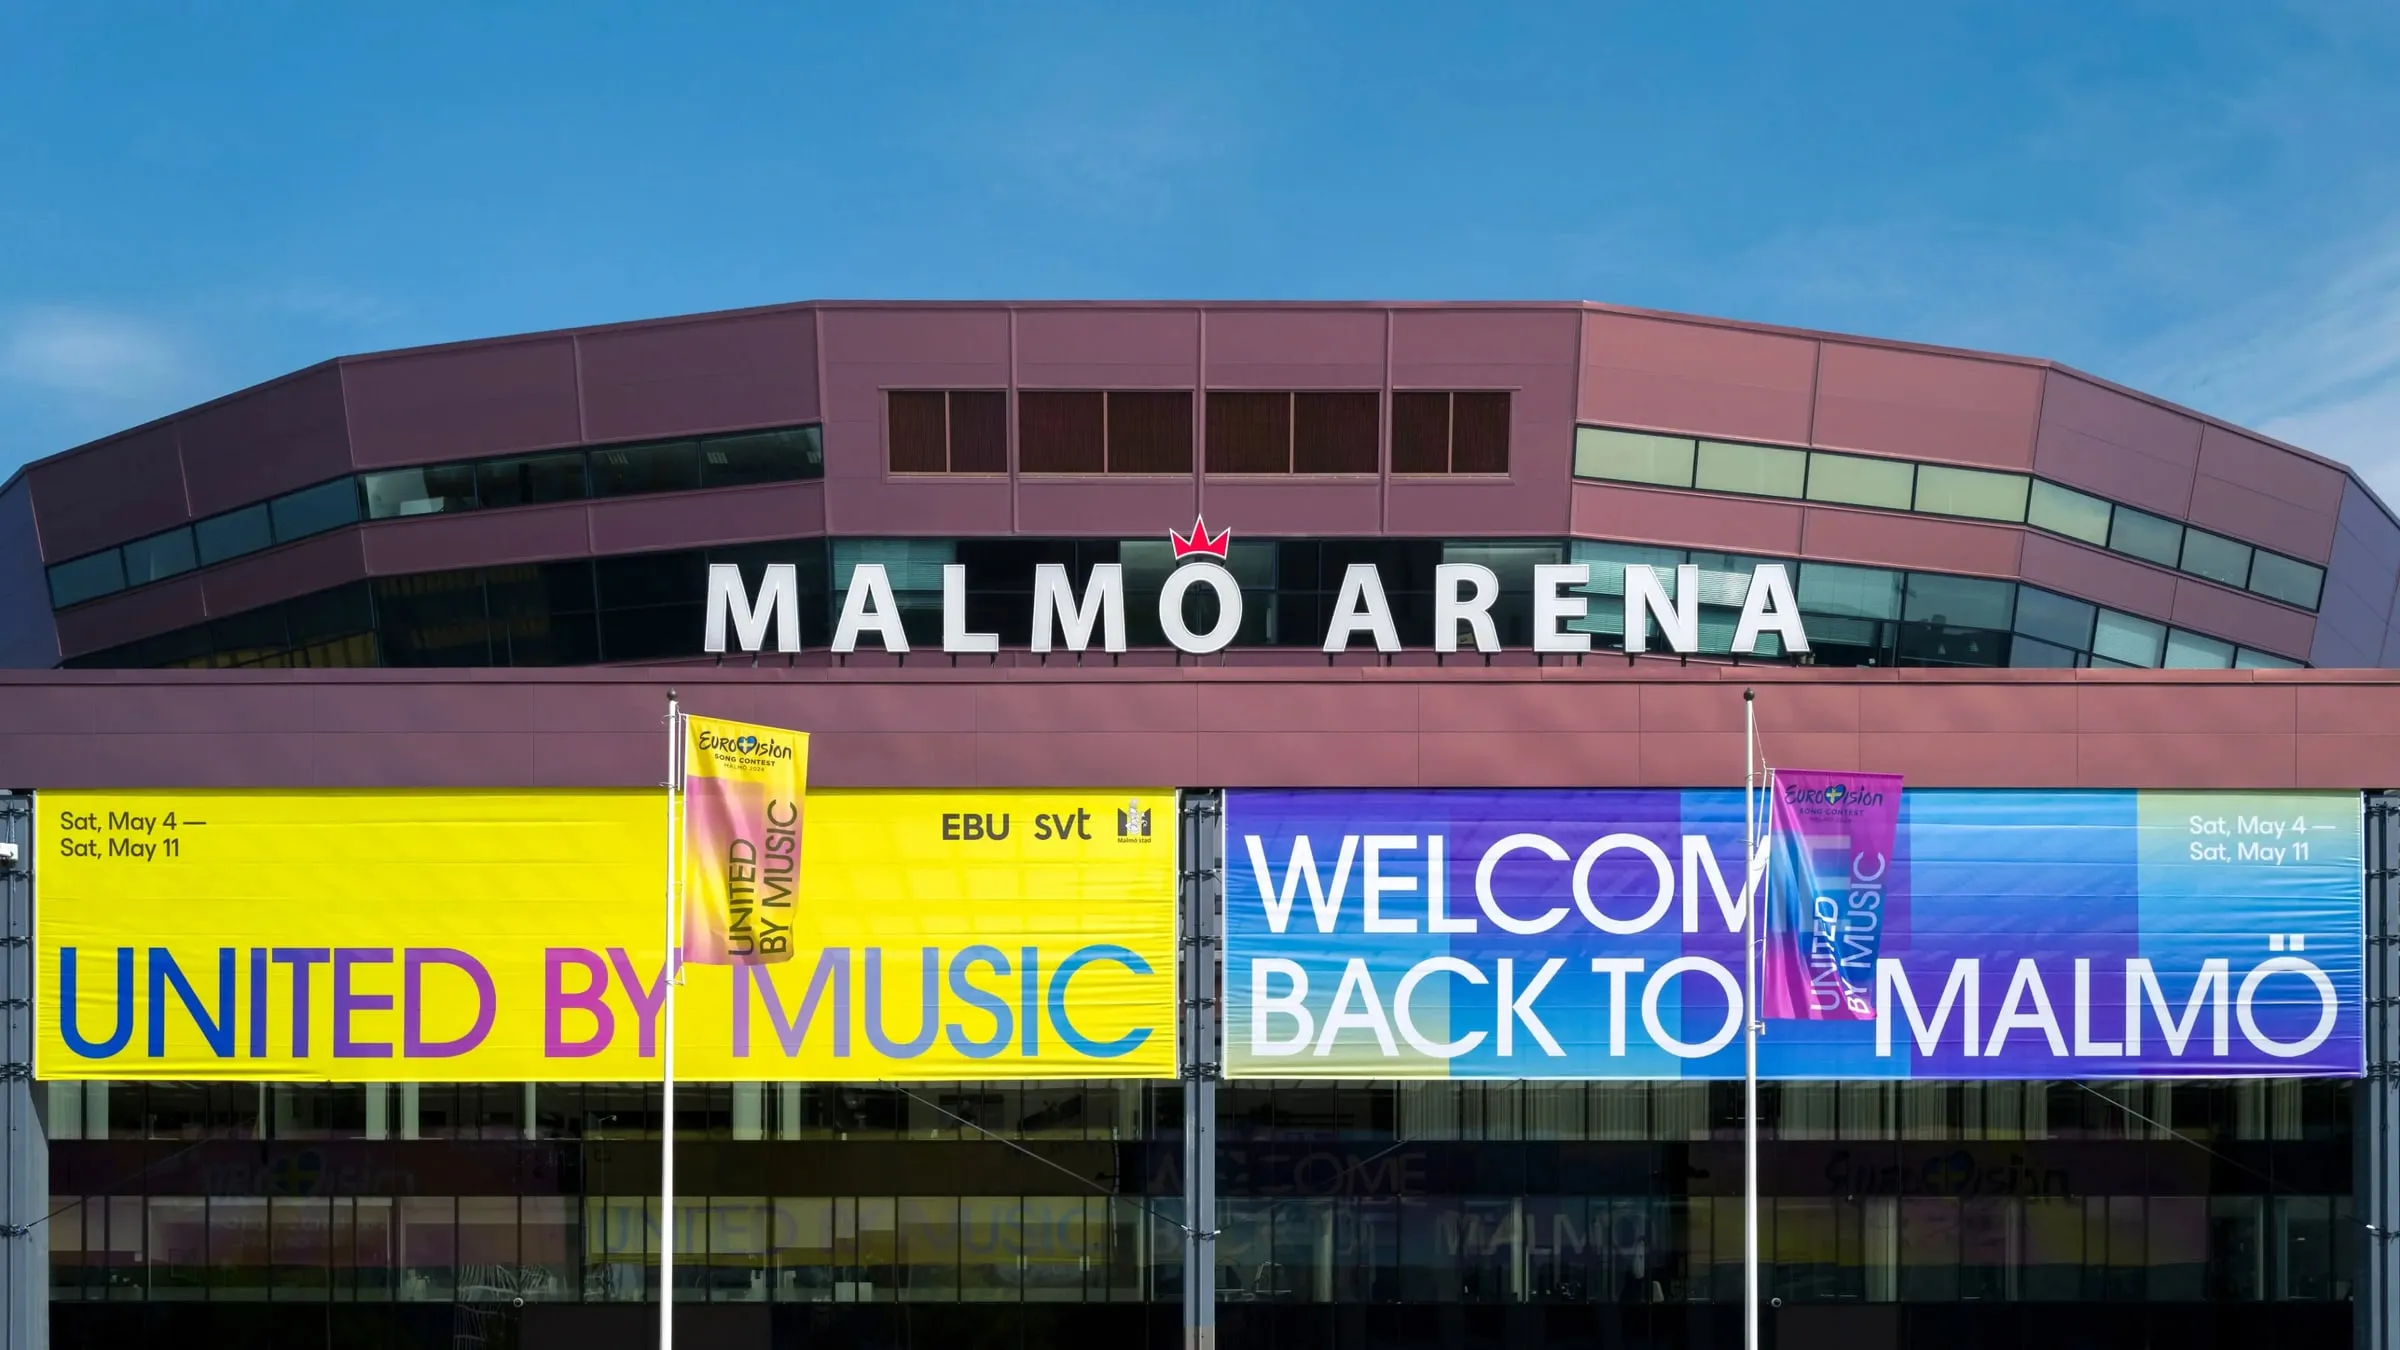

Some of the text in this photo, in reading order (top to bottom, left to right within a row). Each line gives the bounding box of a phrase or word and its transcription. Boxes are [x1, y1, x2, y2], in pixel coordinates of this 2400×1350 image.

[1323, 562, 1810, 654] ARENA
[714, 753, 775, 767] SONG CONTEST
[60, 811, 102, 833] Sat,
[108, 811, 156, 835] May
[162, 812, 177, 830] 4
[942, 808, 1092, 840] EBU svt
[1800, 807, 1864, 817] SONG CONTEST
[2189, 815, 2231, 837] Sat,
[2238, 815, 2286, 839] May
[2291, 816, 2306, 834] 4
[60, 838, 179, 862] Sat, May 11
[760, 799, 797, 954] BY MUSIC
[2189, 841, 2308, 865] Sat, May 11
[728, 838, 757, 956] UNITED
[1811, 896, 1841, 1012] UNITED
[1841, 851, 1886, 1015] BY MUSIC
[60, 944, 1153, 1059] UNITED BY MUSIC
[1251, 935, 2338, 1058] BACK TO MALMÖ
